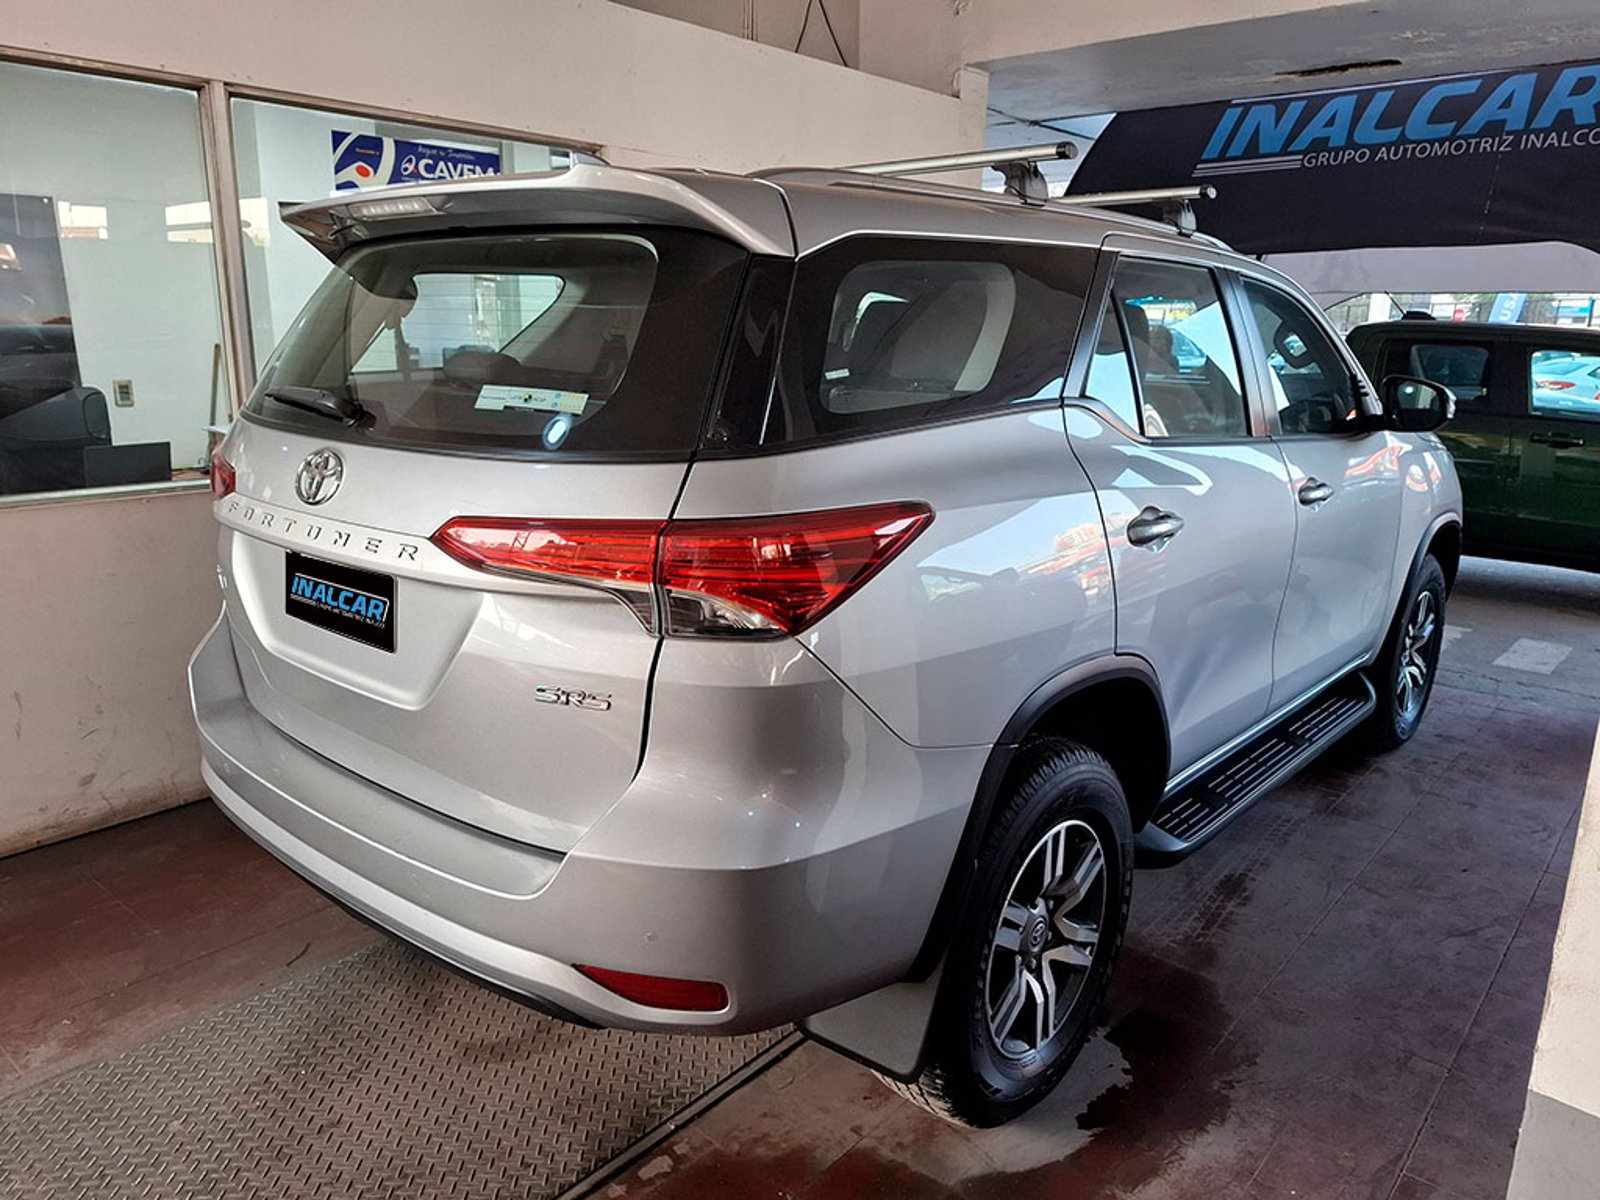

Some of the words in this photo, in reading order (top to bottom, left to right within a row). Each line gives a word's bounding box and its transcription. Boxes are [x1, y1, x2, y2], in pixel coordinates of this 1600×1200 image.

[1201, 64, 1600, 160] INALCAR
[1303, 149, 1370, 168] GRUPO
[1374, 135, 1515, 161] AUTOMOTRIZ
[1520, 127, 1600, 150] INALCO
[228, 501, 419, 561] FORTUNER
[291, 576, 385, 622] INALCAR
